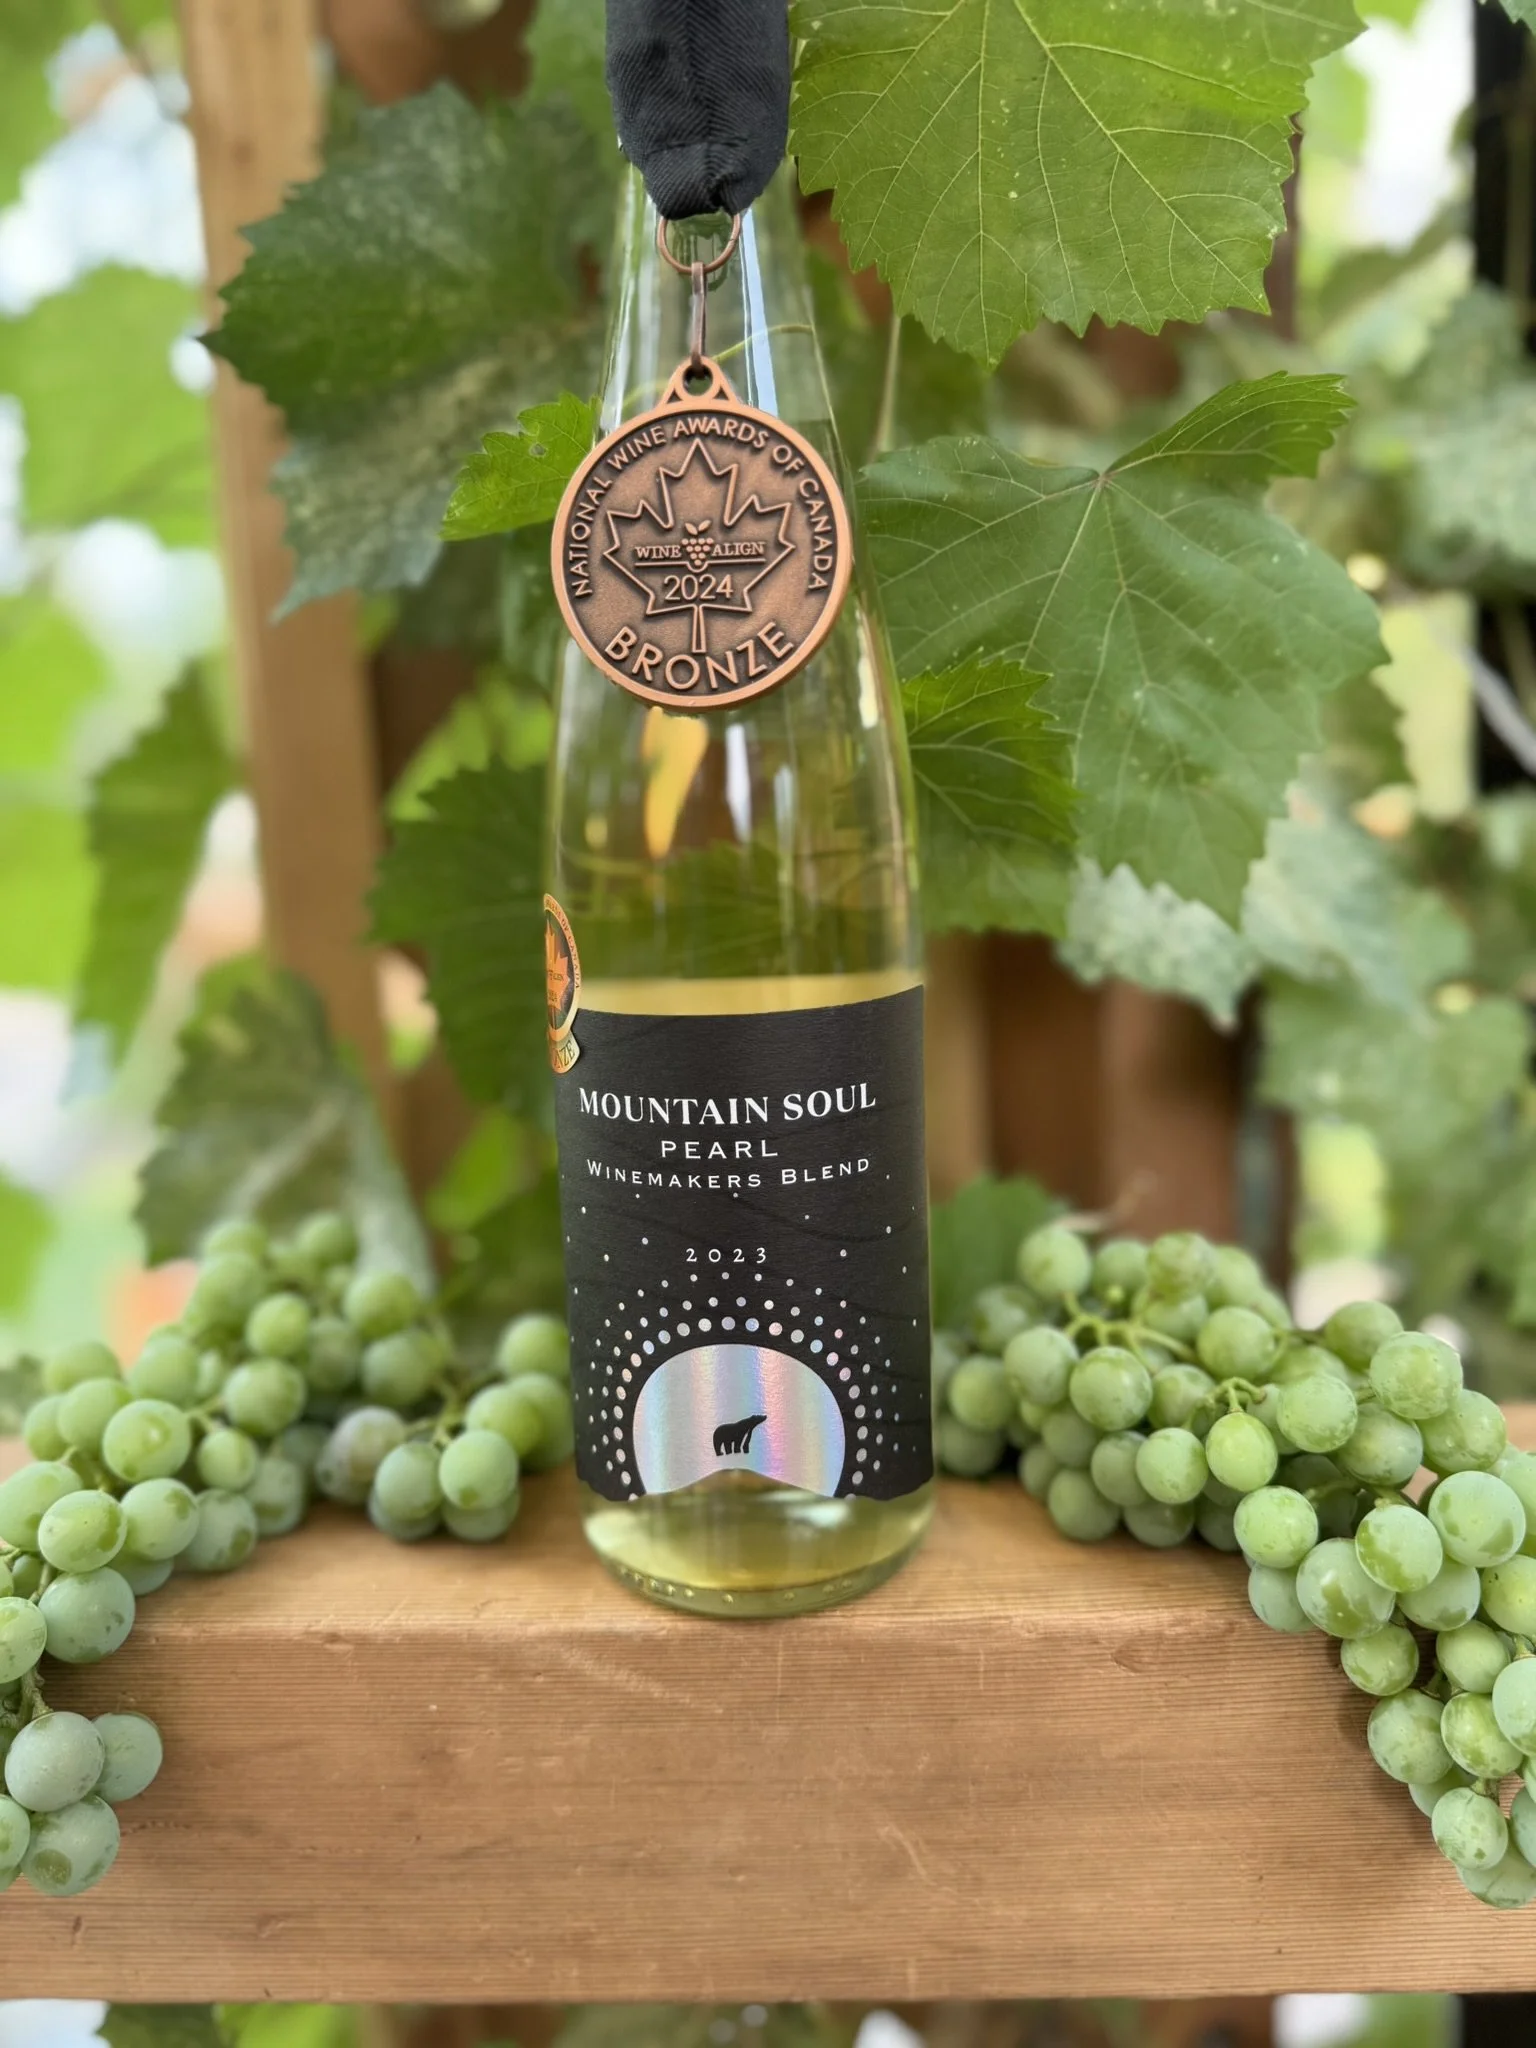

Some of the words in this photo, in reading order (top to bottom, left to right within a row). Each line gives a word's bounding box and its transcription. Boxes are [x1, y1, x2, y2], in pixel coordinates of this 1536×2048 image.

[569, 475, 613, 597] NATIONAL
[607, 425, 667, 471] WINE
[673, 416, 769, 450] AWARDS
[773, 444, 804, 475] OF
[799, 478, 833, 592] CANADA
[635, 545, 682, 560] WINE
[712, 541, 766, 557] ALIGN
[663, 574, 734, 601] 2024
[604, 622, 794, 691] BRONZE
[578, 1087, 769, 1126] MOUNTAIN
[782, 1082, 877, 1121] SOUL
[661, 1139, 778, 1159] PEARL
[586, 1159, 762, 1189] WINEMAKERS
[781, 1158, 870, 1185] BLEND
[685, 1248, 767, 1264] 2023
